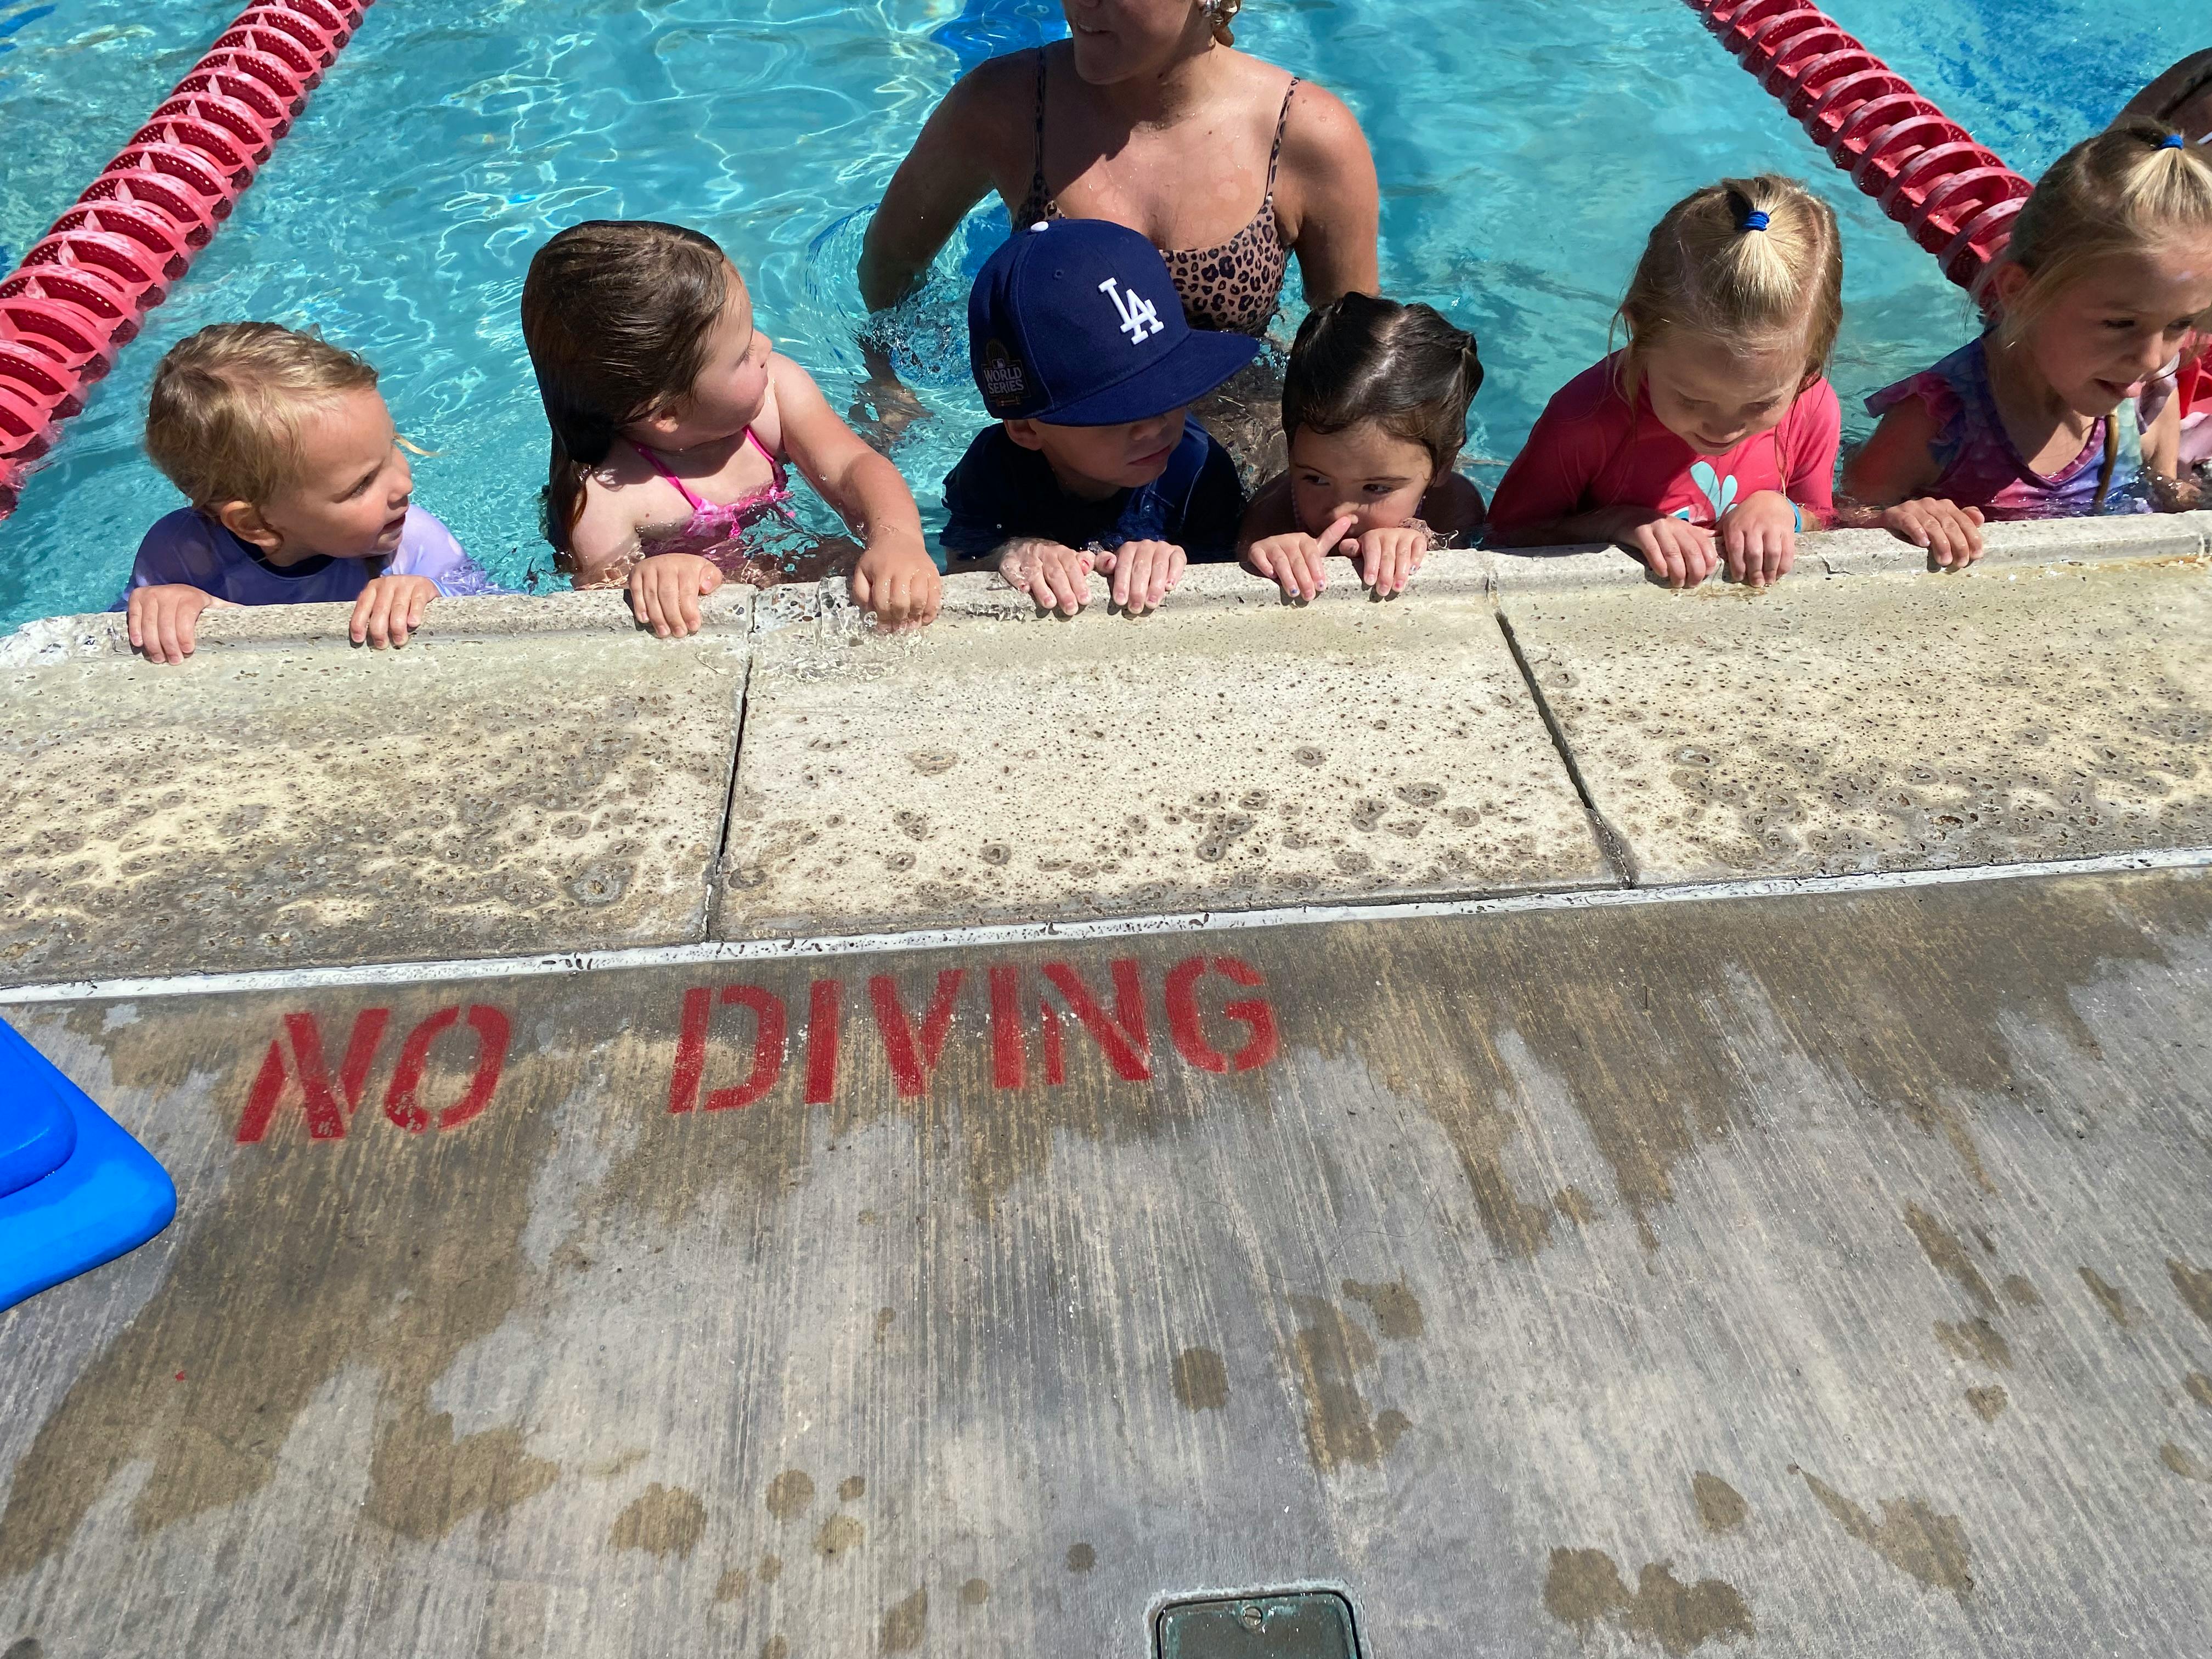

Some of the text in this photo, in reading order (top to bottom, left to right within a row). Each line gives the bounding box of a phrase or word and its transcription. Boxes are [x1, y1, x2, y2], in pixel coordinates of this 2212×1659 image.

[1098, 277, 1164, 345] LA
[984, 367, 1022, 382] WORLD
[988, 379, 1024, 394] SERIES
[235, 955, 1280, 1144] NO DIVING
